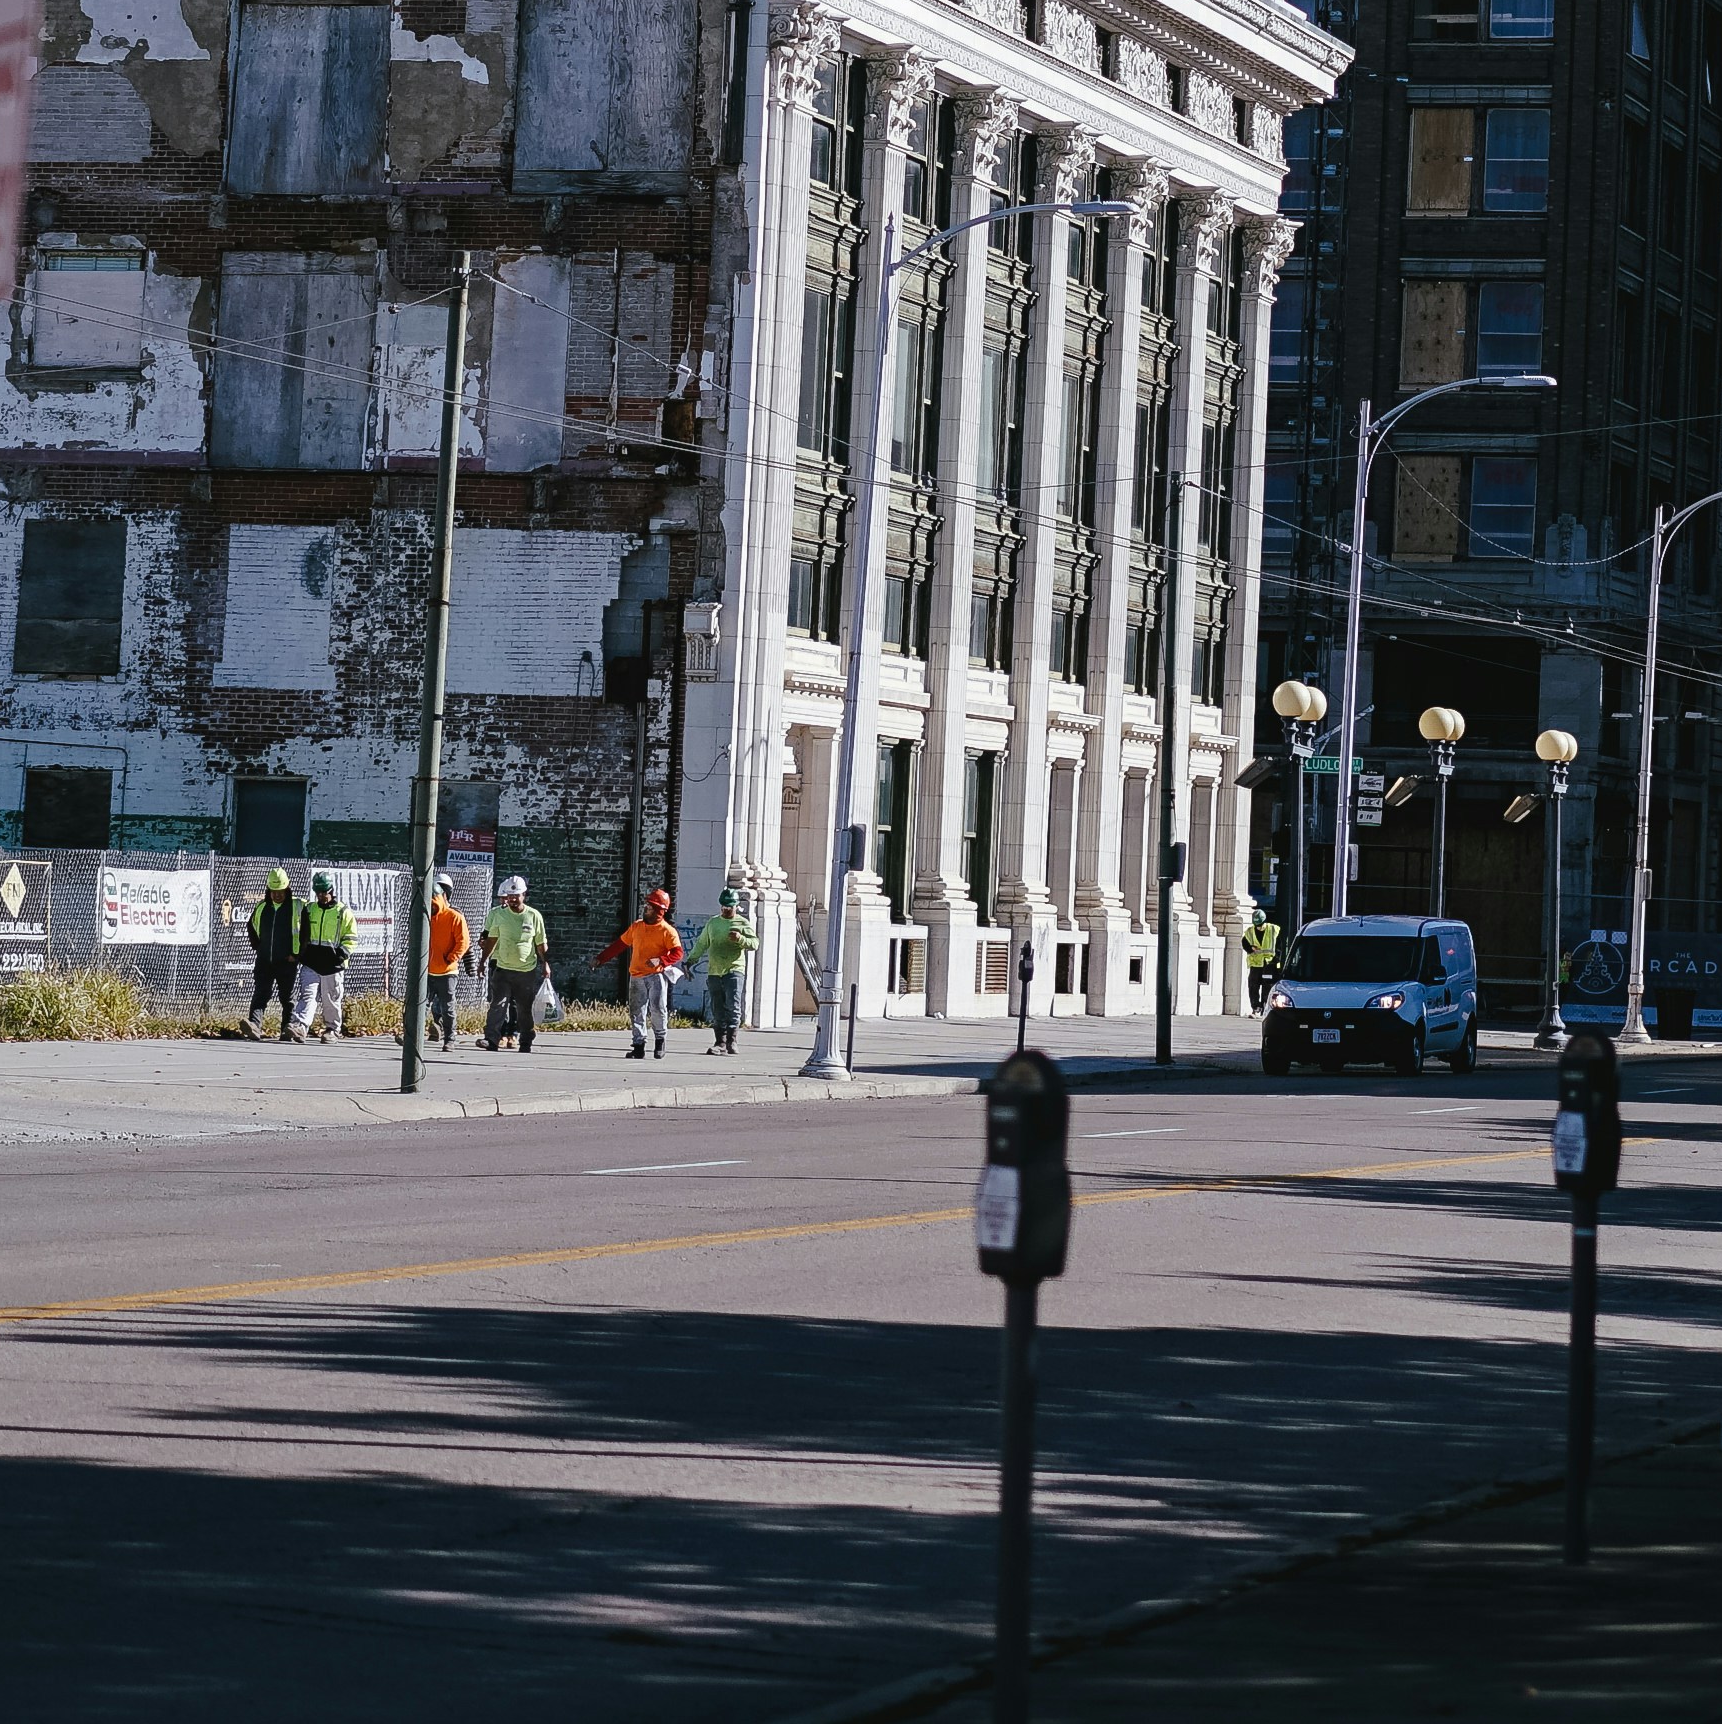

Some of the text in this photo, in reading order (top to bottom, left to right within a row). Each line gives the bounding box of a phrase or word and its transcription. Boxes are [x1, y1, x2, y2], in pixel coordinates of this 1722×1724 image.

[1307, 759, 1341, 770] LUDLO
[449, 853, 493, 862] AVAILABLE
[120, 883, 171, 904] Reliable
[120, 905, 177, 926] Electric
